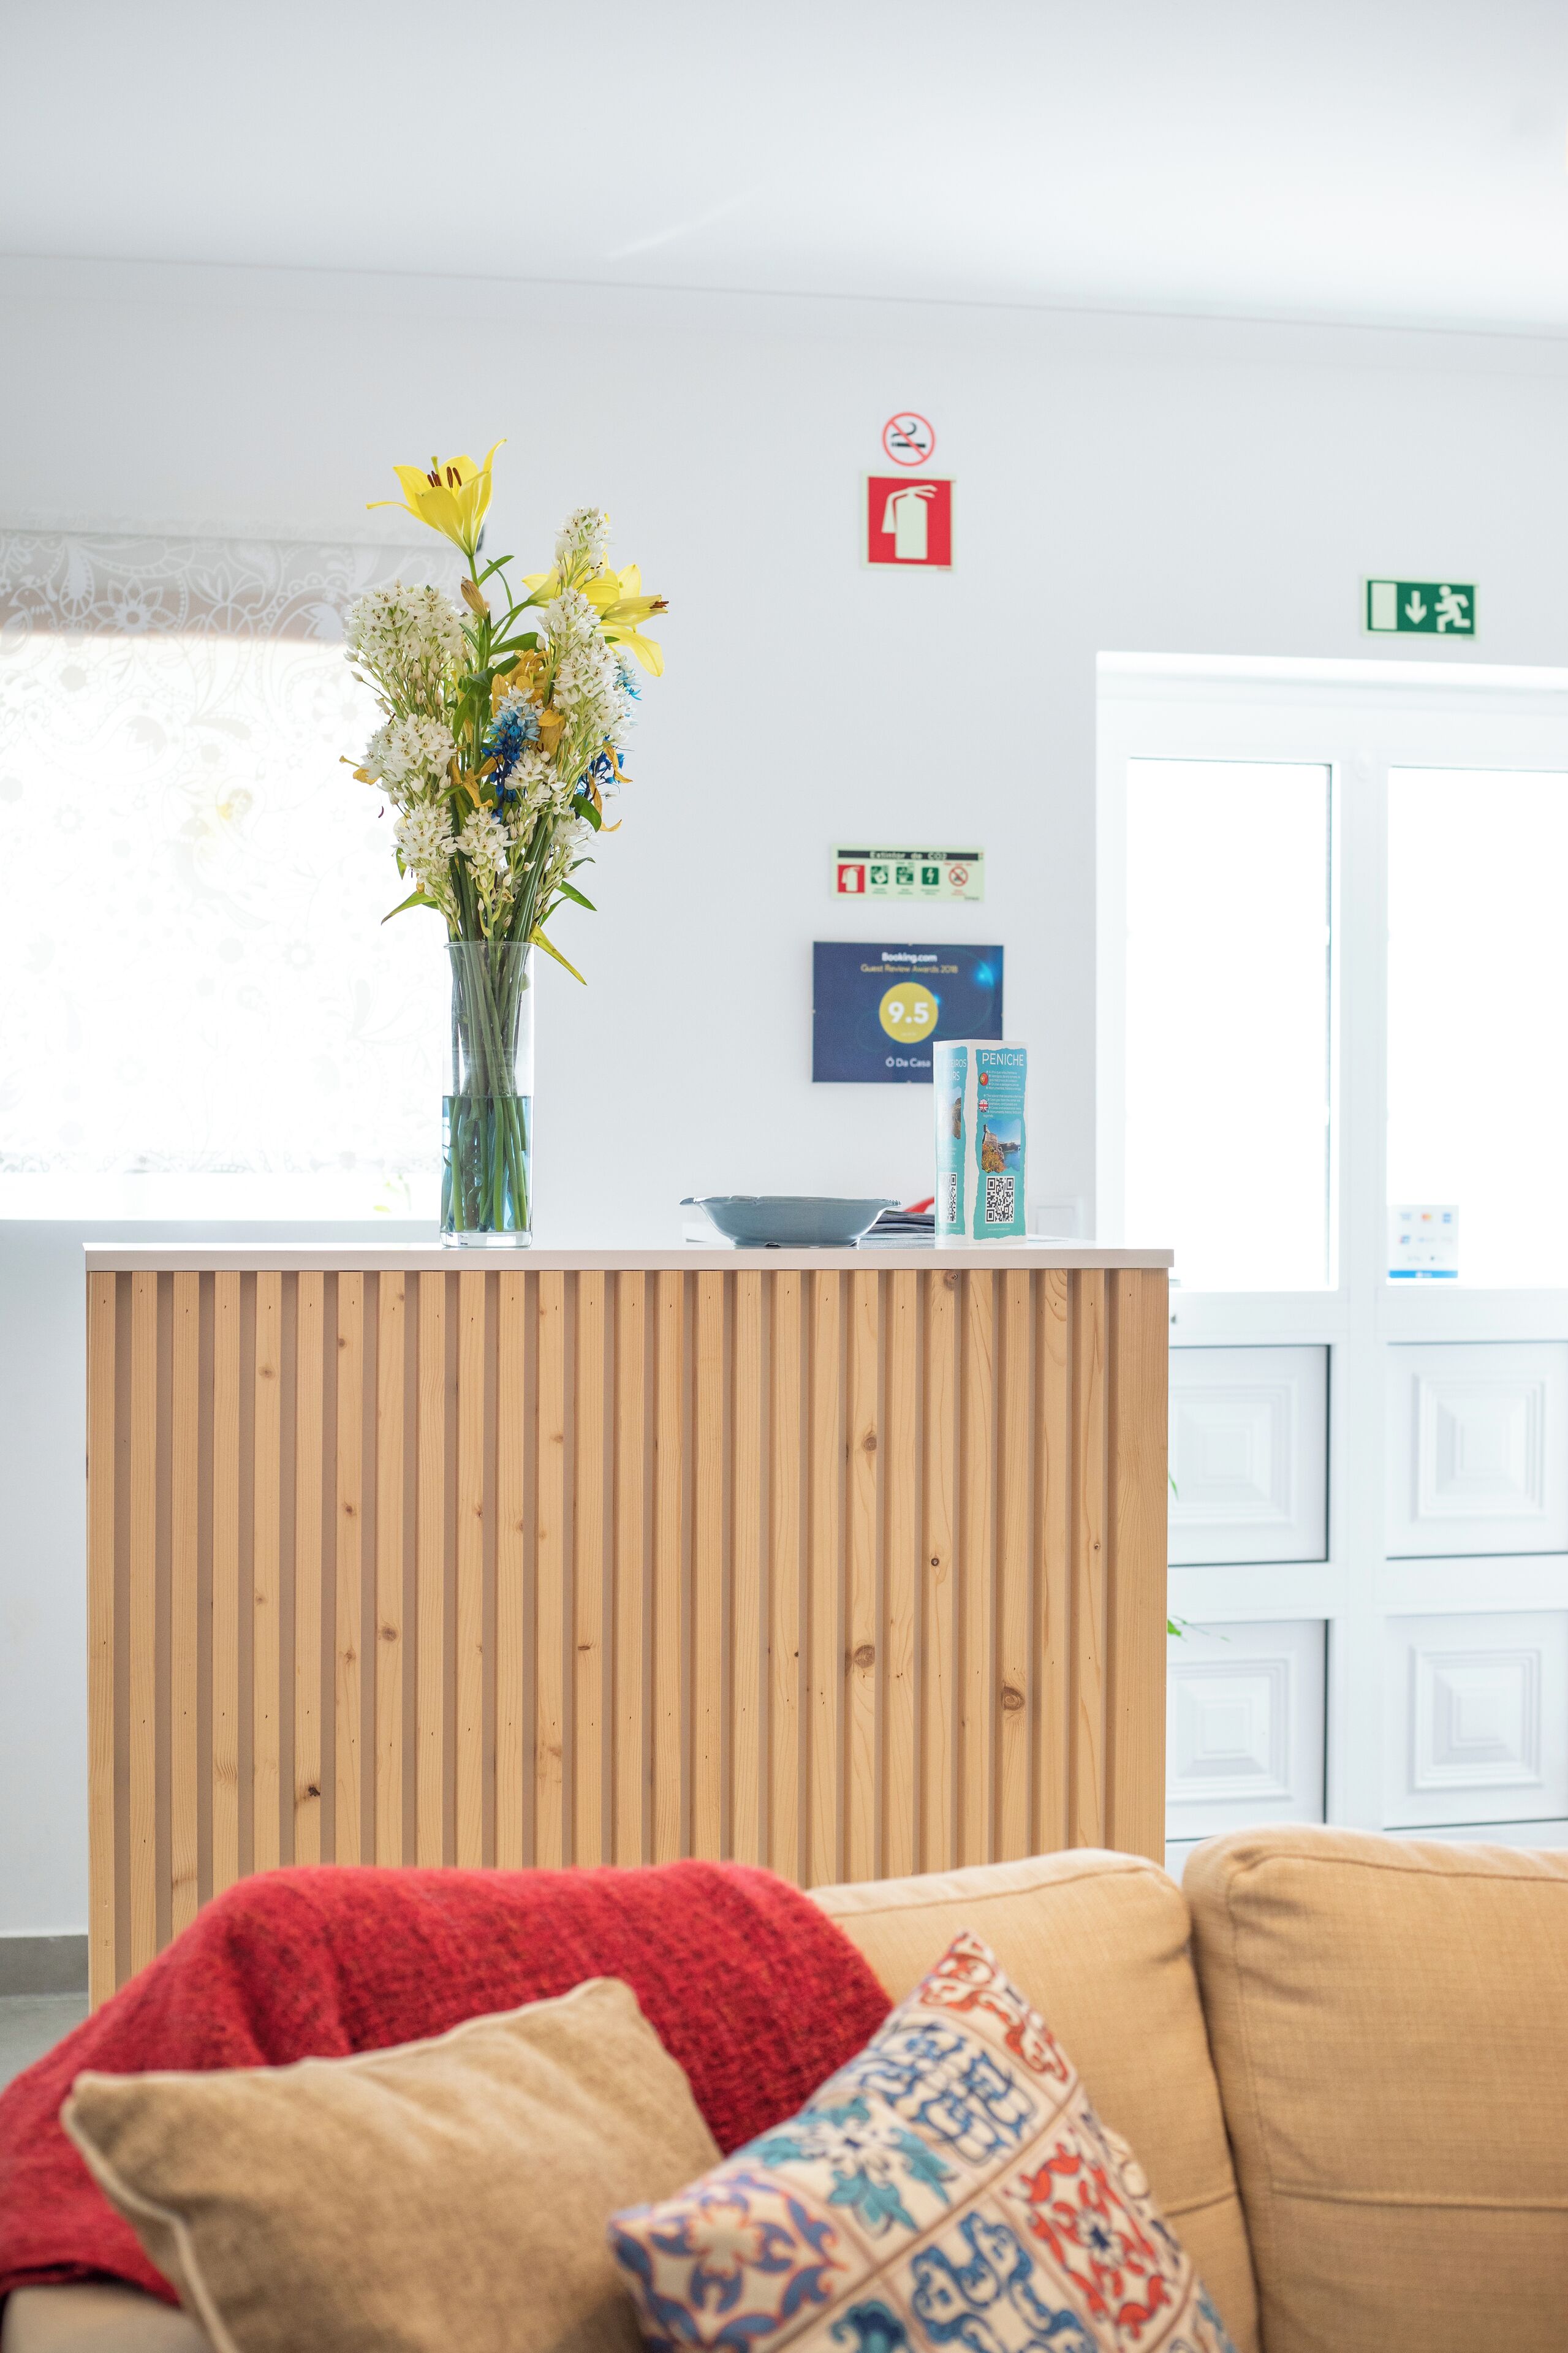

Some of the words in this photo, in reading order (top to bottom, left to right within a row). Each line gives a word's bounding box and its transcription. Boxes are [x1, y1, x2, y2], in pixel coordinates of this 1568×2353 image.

[882, 952, 937, 964] Booking.com
[860, 963, 883, 972] Guest
[884, 964, 911, 973] Review
[912, 964, 939, 973] Awards
[888, 1001, 929, 1025] 9.5
[896, 1058, 909, 1067] Da
[909, 1058, 931, 1067] Casa
[982, 1053, 1024, 1066] PENICHE
